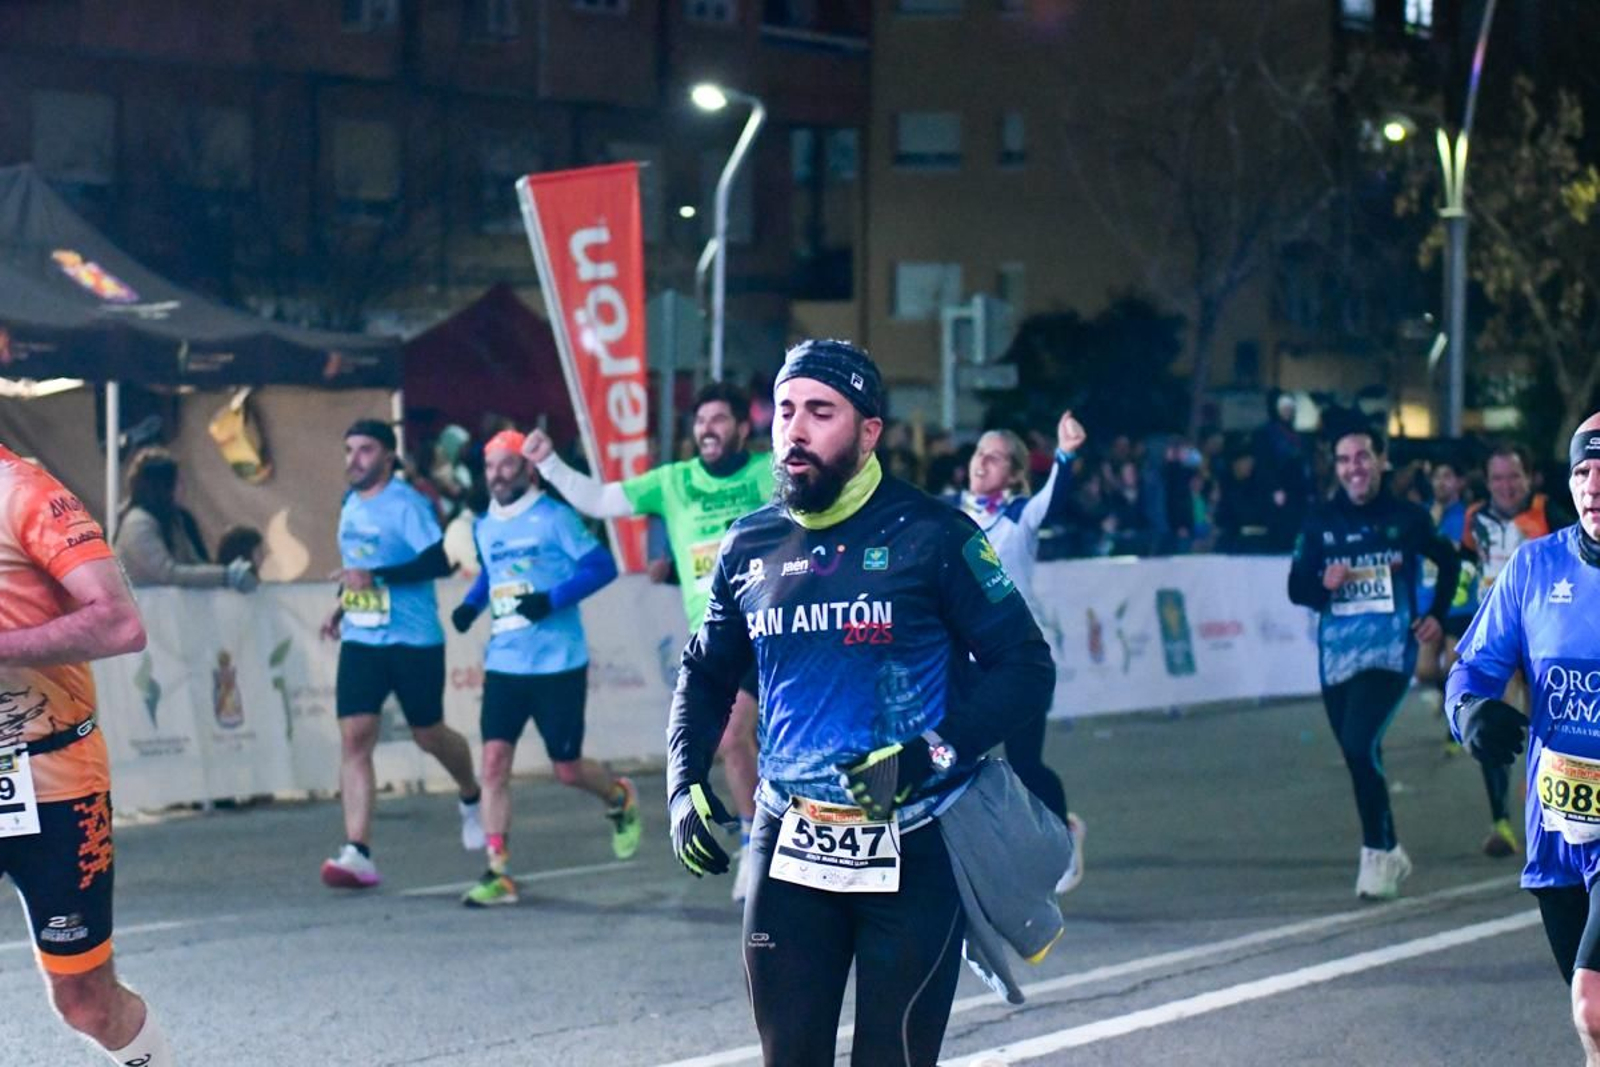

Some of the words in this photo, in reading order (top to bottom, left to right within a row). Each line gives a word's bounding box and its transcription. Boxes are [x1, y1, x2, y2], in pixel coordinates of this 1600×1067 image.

[746, 607, 783, 640] SAN
[791, 592, 892, 633] ANTÓN
[842, 619, 895, 645] 2025
[1543, 776, 1600, 814] 398
[791, 817, 886, 857] 5547
